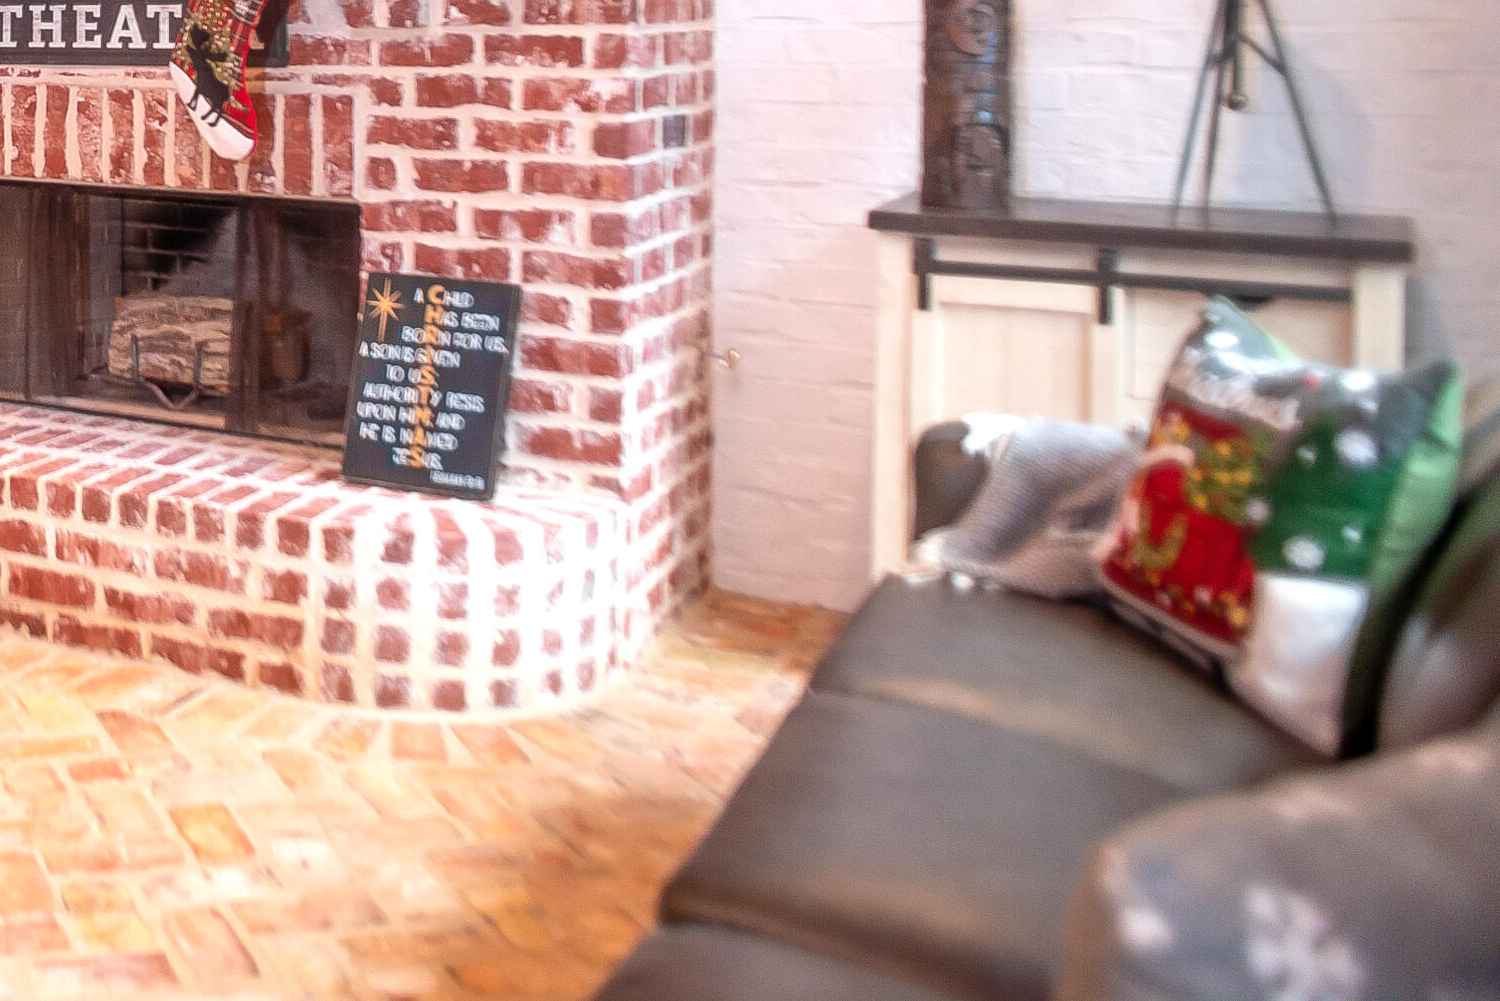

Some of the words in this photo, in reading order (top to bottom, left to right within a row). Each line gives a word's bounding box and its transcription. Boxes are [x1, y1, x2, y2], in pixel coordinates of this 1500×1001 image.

[413, 287, 425, 304] A
[385, 363, 405, 382] TO
[356, 400, 397, 421] UPON
